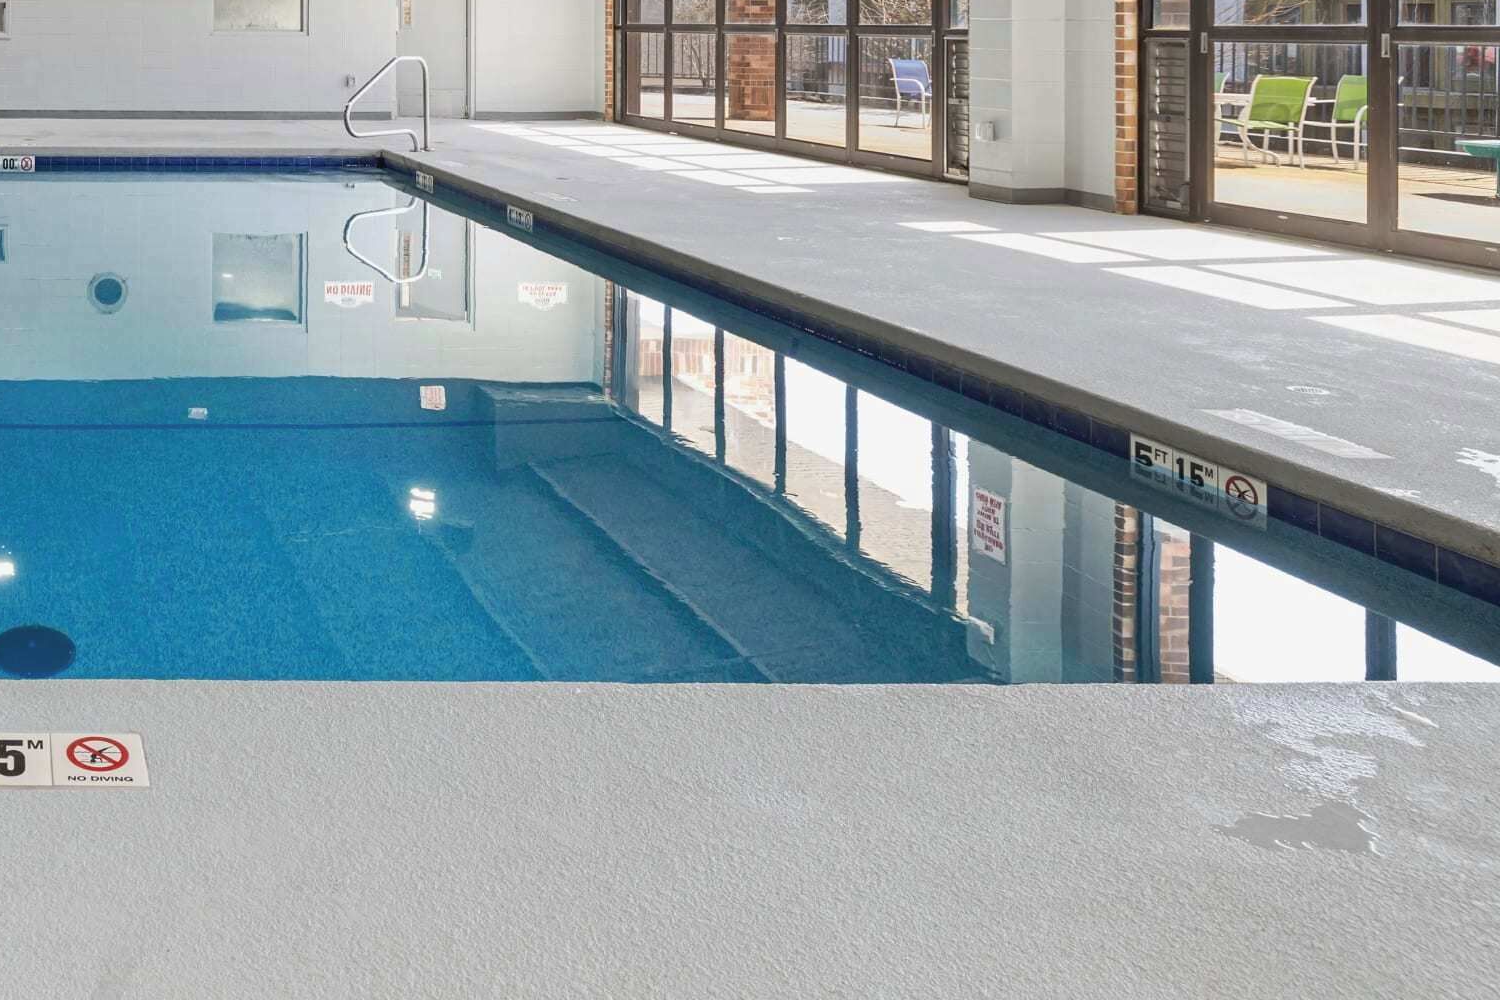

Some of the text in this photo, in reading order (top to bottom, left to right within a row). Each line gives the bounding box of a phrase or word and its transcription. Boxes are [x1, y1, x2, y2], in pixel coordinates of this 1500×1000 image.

[1154, 449, 1168, 464] FT
[1205, 467, 1213, 479] M
[27, 740, 44, 750] M
